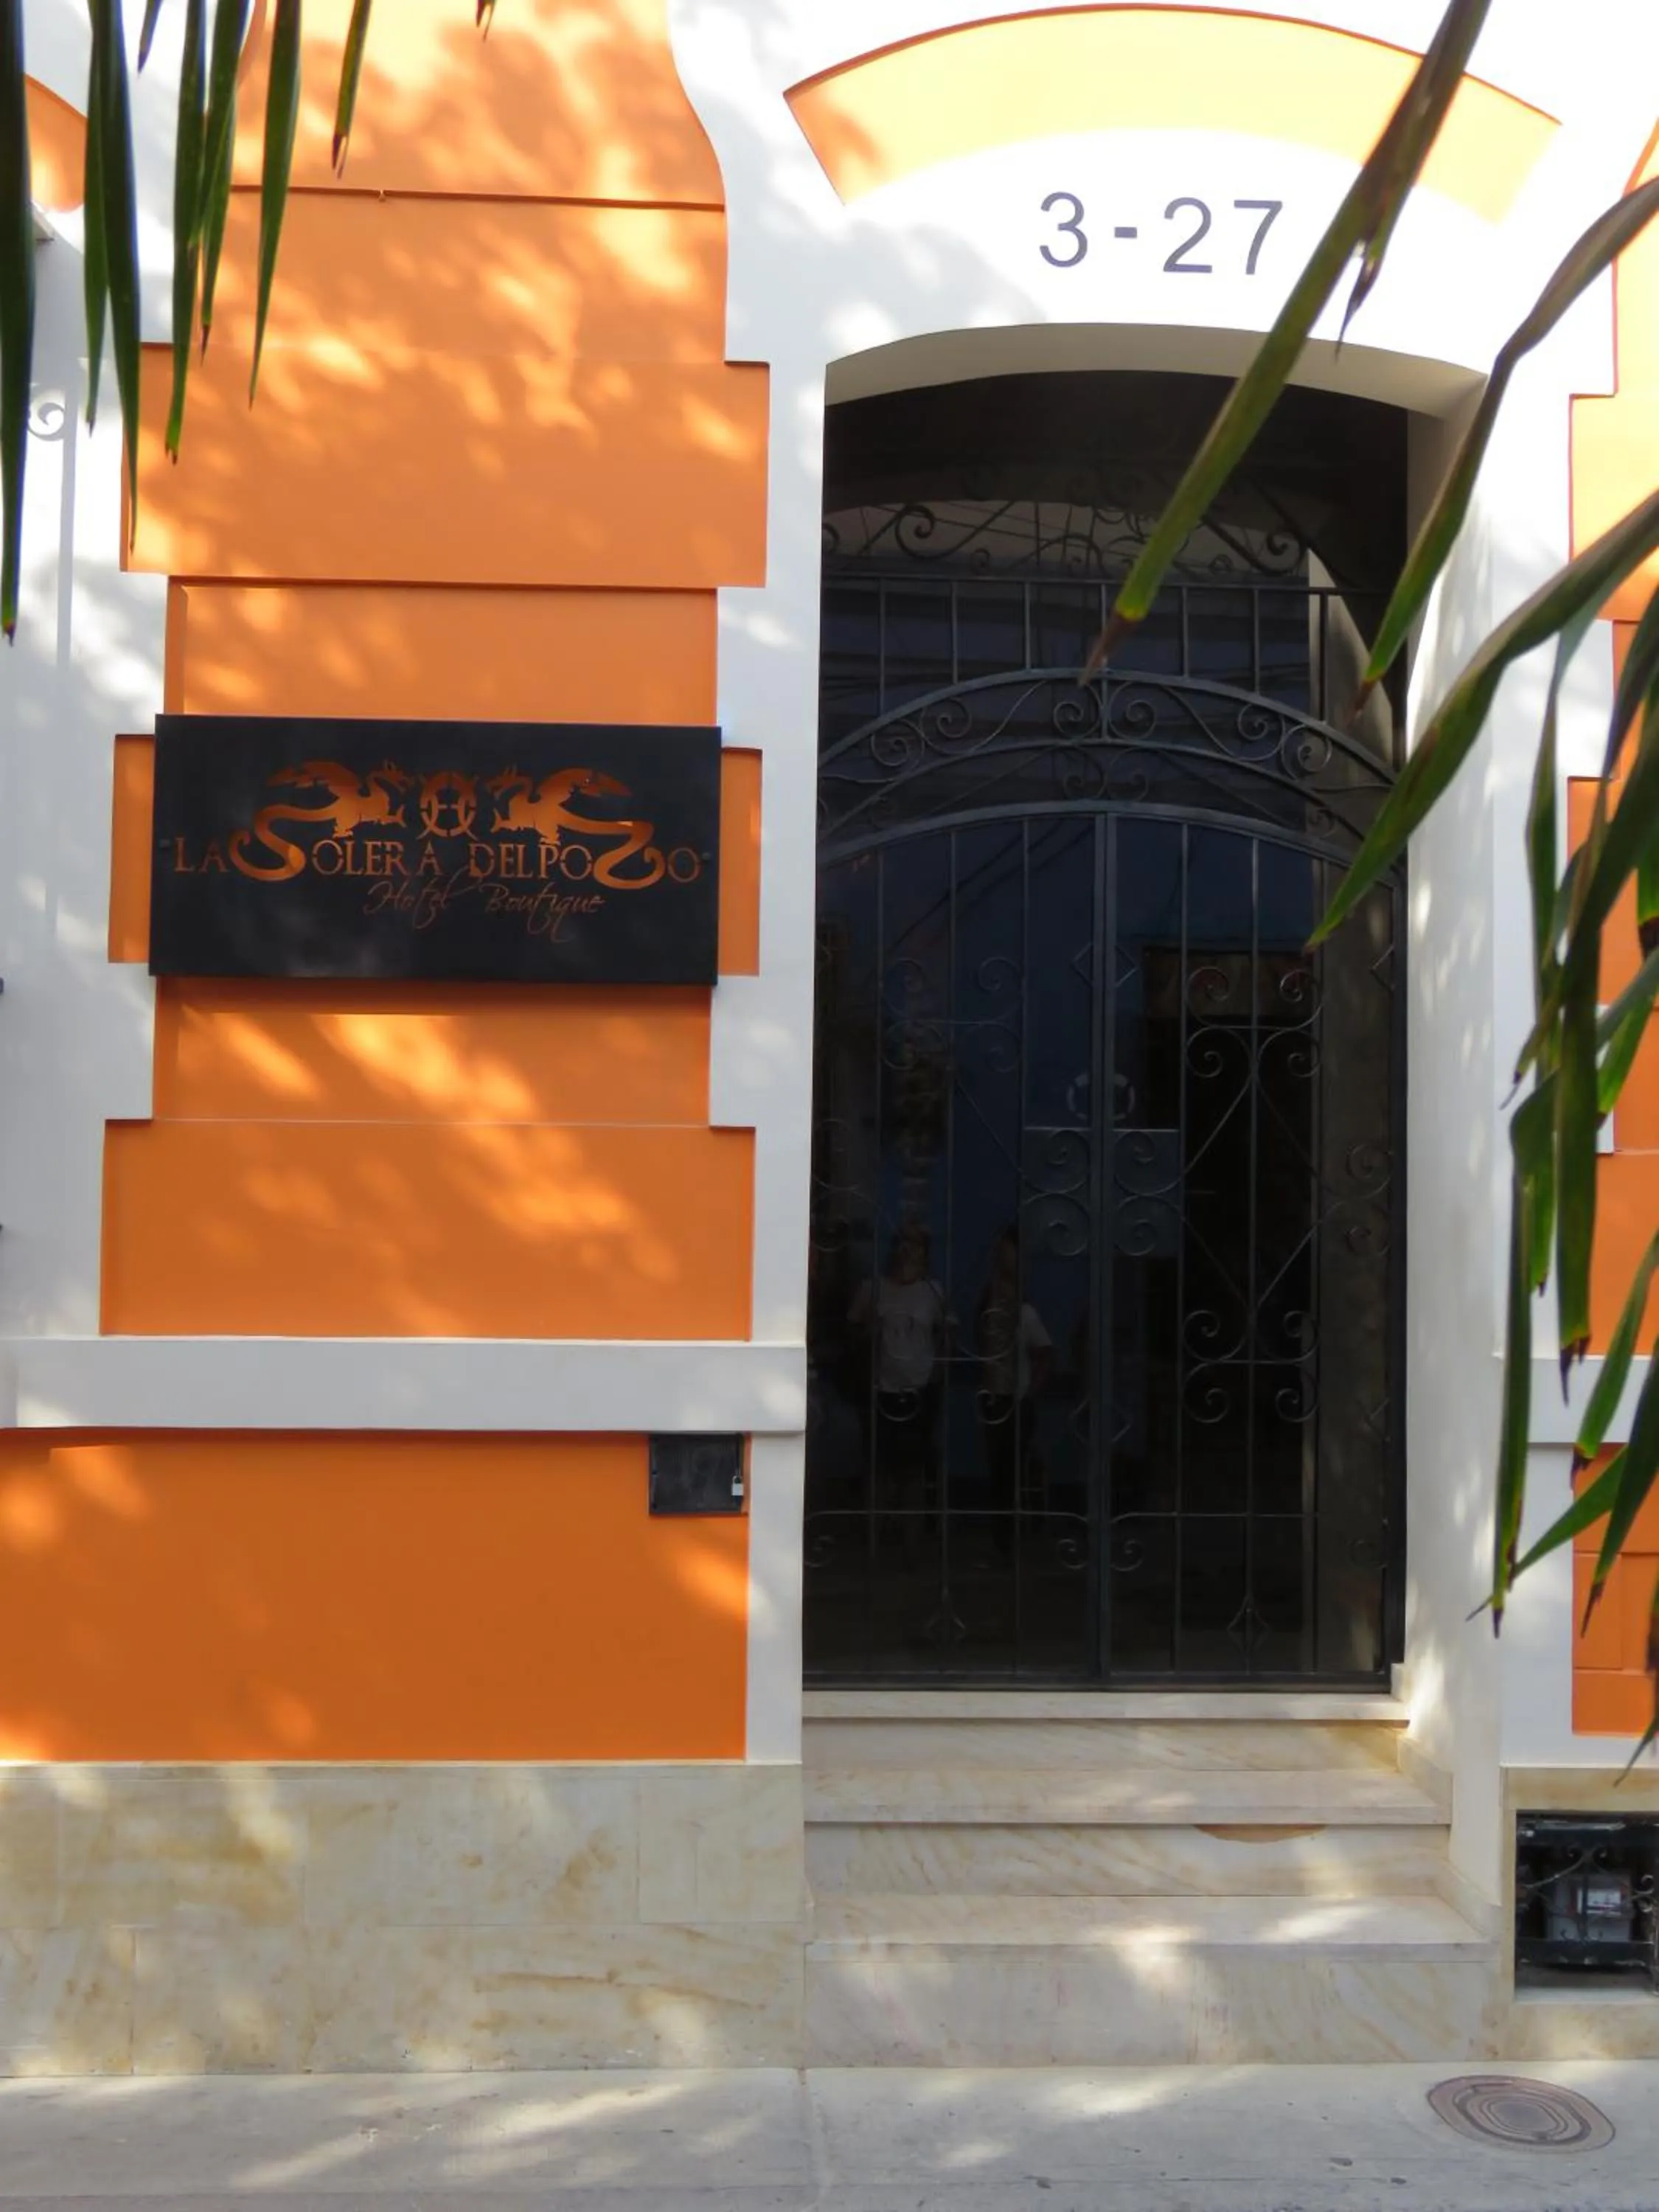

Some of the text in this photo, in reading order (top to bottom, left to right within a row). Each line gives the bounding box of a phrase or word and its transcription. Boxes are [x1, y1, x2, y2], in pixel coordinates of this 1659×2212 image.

[1040, 192, 1283, 275] 3-27
[173, 837, 229, 873] LA
[362, 866, 605, 944] Hotel Boutique
